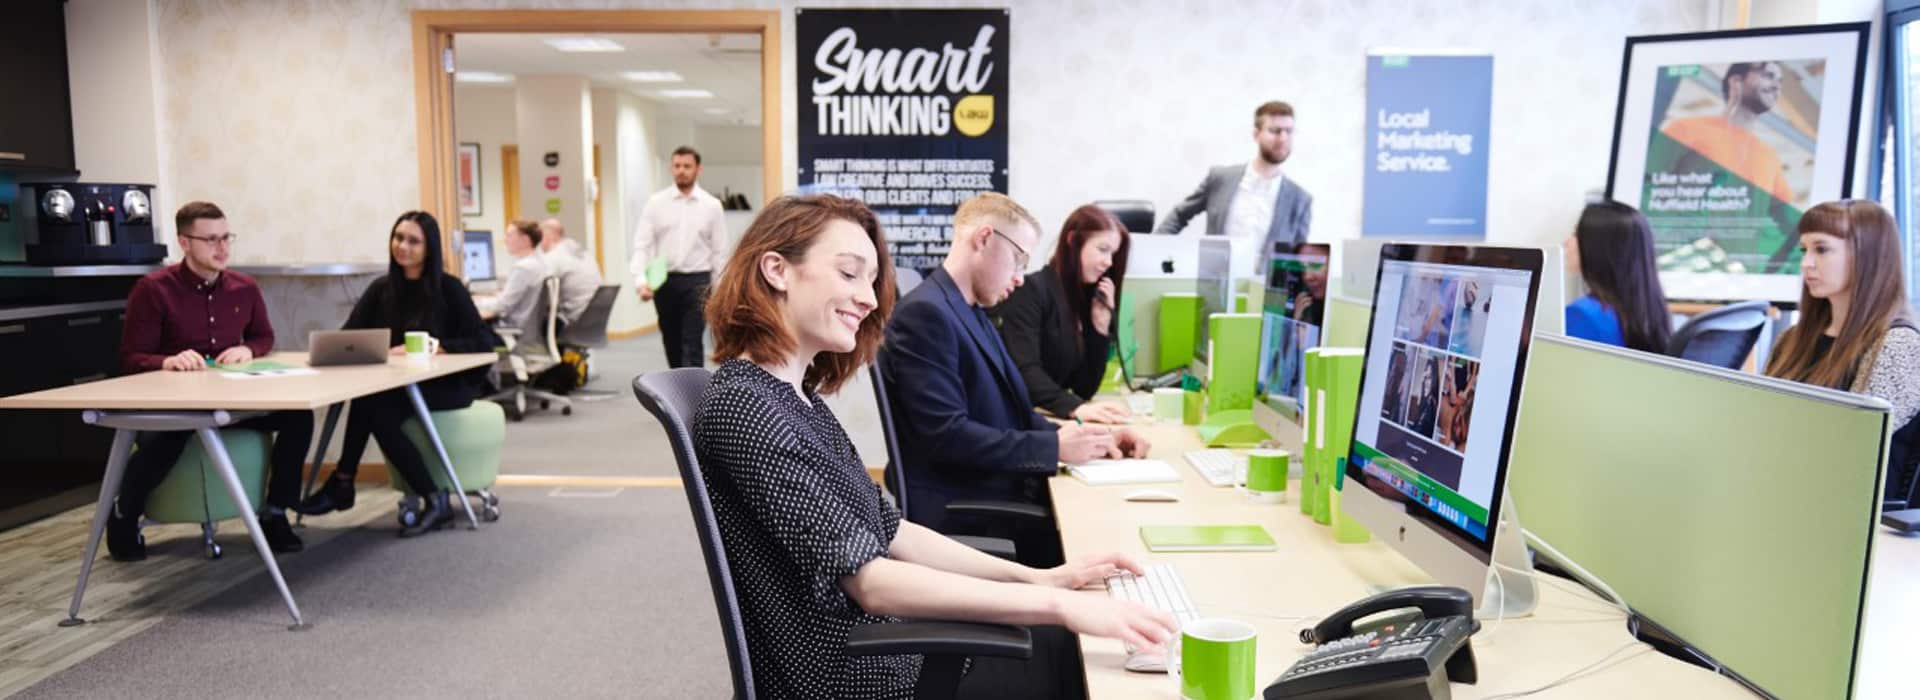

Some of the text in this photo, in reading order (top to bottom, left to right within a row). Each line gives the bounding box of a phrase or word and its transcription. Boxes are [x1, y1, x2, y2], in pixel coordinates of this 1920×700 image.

[812, 24, 996, 96] Smart
[812, 95, 950, 135] THINKING
[1377, 108, 1430, 128] Local
[1377, 131, 1473, 155] Marketing
[814, 158, 844, 172] SMART
[846, 158, 887, 172] THINKING
[887, 159, 897, 172] IS
[1376, 152, 1451, 171] Service.
[838, 173, 886, 188] CREATIVE
[886, 174, 908, 188] AND
[887, 190, 930, 205] CLIENTS
[931, 190, 954, 205] AND
